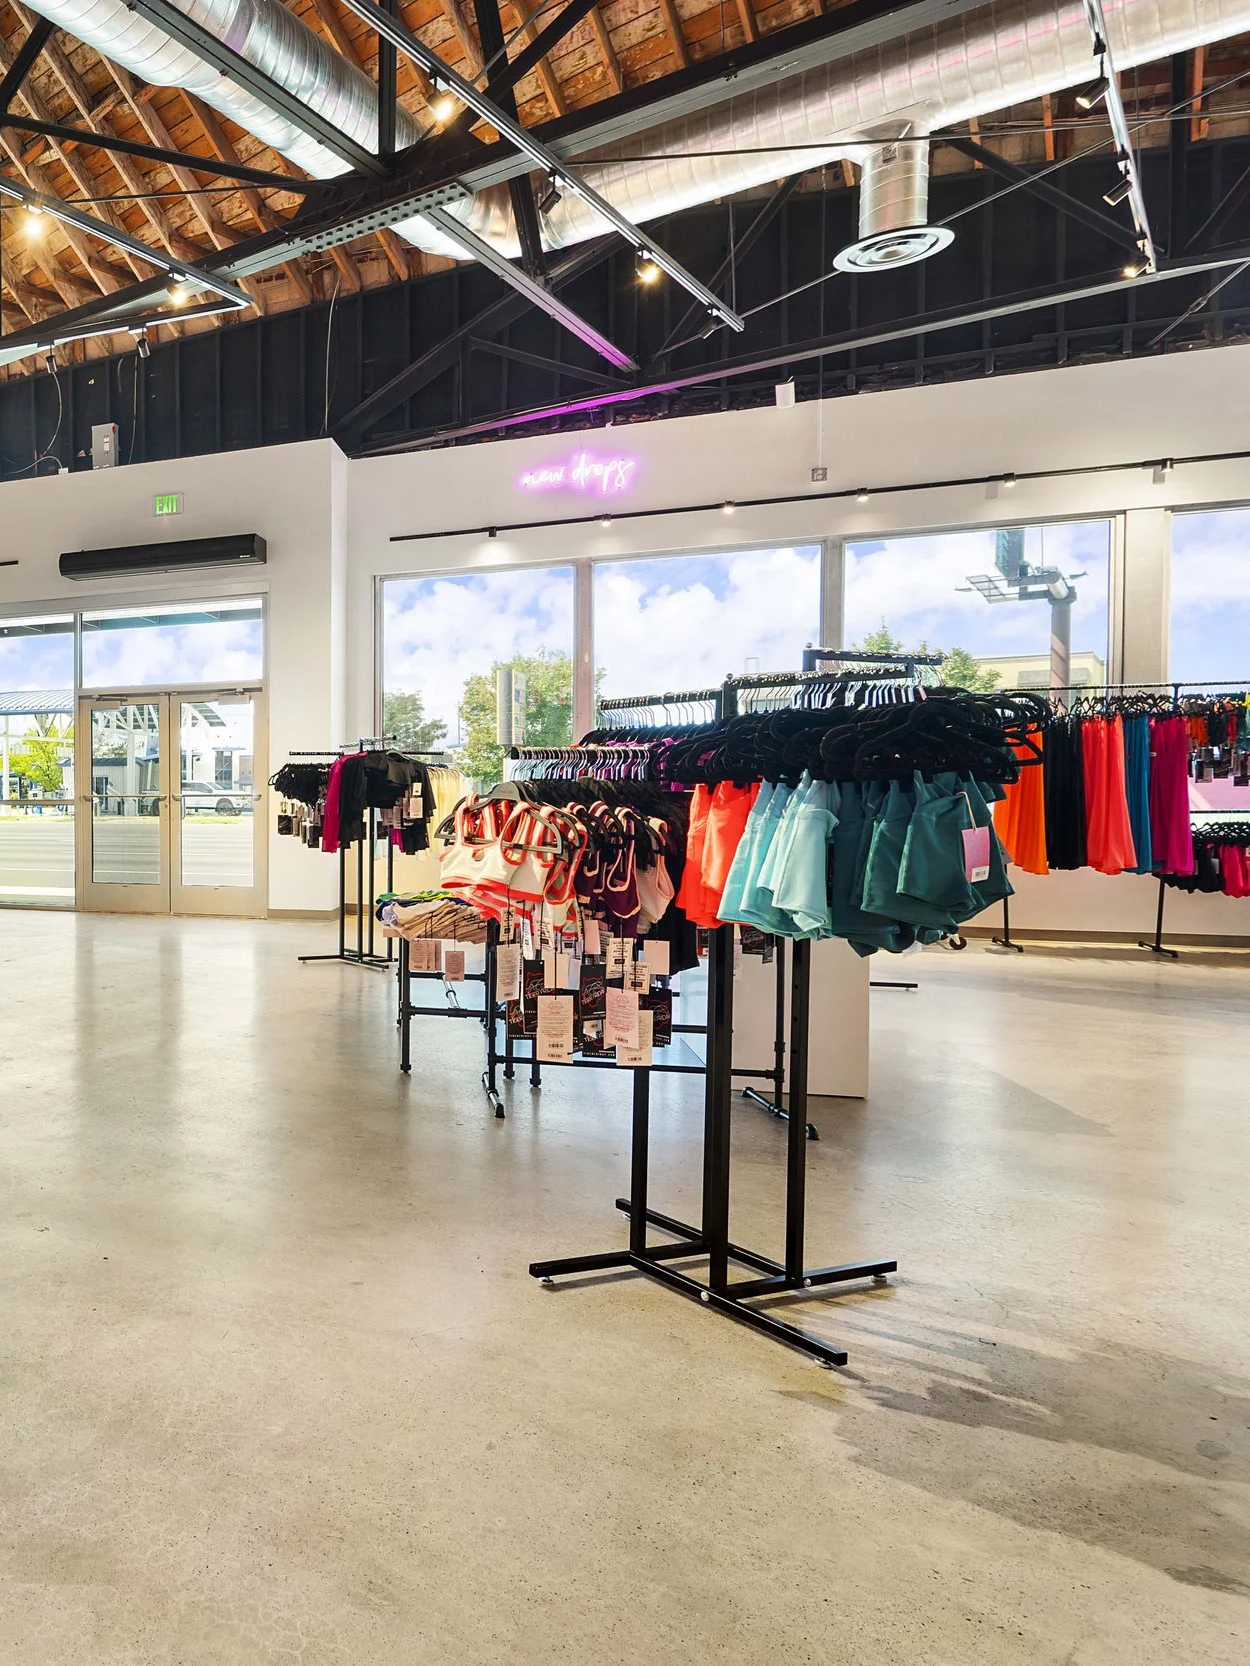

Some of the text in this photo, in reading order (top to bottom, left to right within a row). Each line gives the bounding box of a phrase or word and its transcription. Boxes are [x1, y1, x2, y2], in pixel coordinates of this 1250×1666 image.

[521, 453, 636, 493] new drops
[155, 494, 178, 515] EXIT
